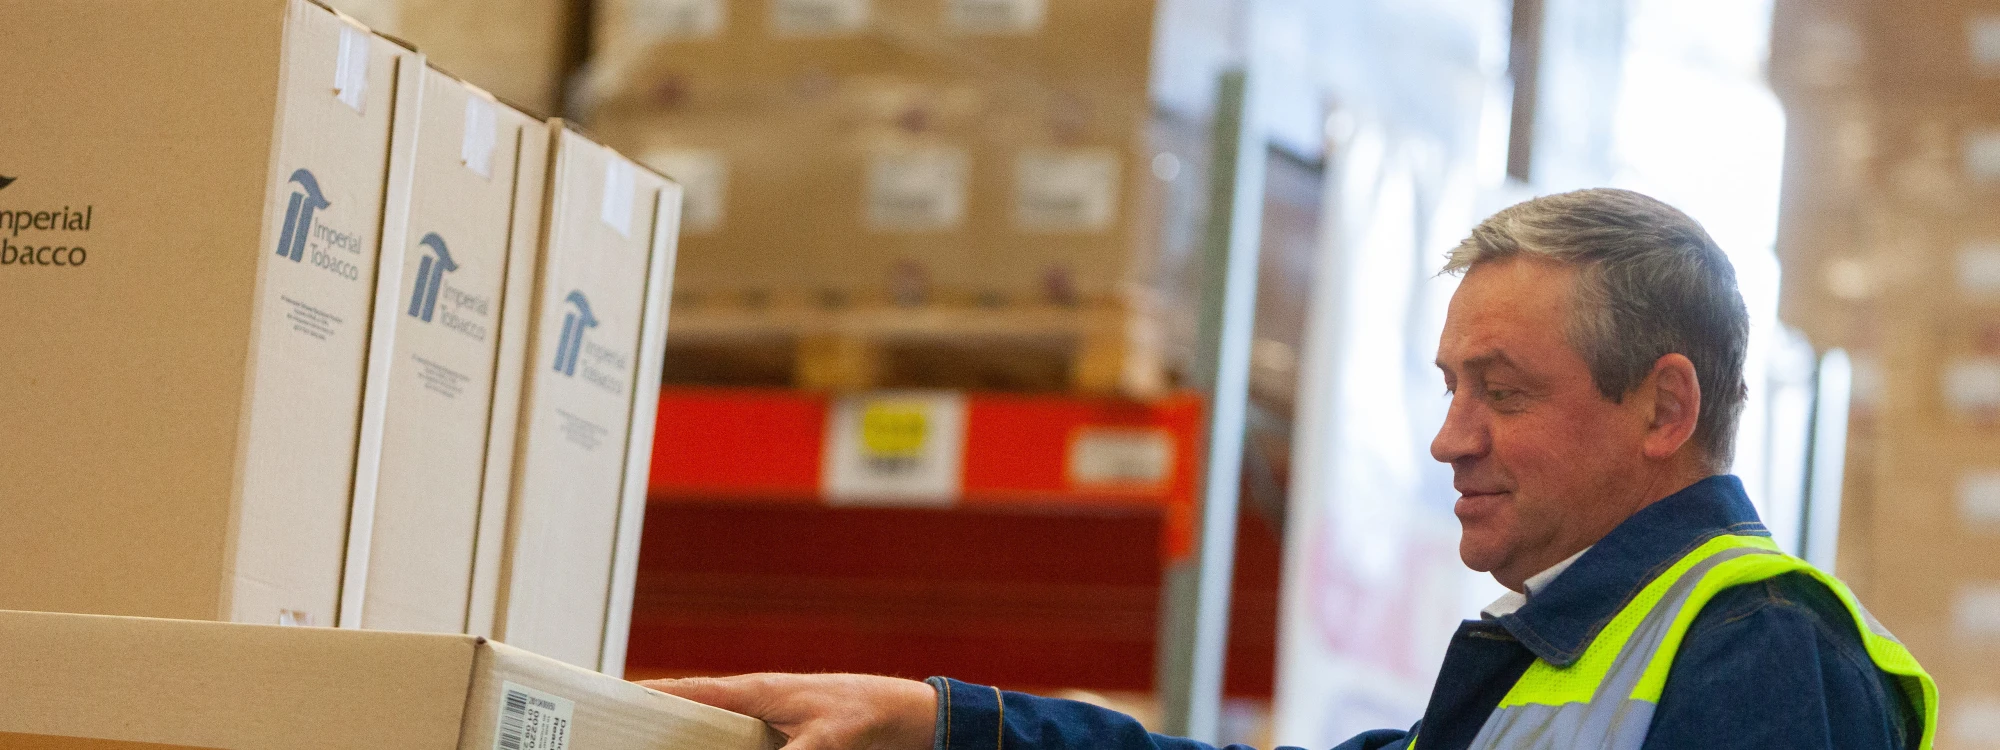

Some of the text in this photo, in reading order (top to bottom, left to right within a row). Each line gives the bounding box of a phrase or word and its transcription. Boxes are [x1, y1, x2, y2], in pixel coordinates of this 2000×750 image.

[0, 205, 92, 236] mperial
[313, 217, 362, 254] Imperial
[0, 238, 87, 266] bacco
[309, 243, 359, 281] Tobacco
[550, 717, 559, 750] Reac
